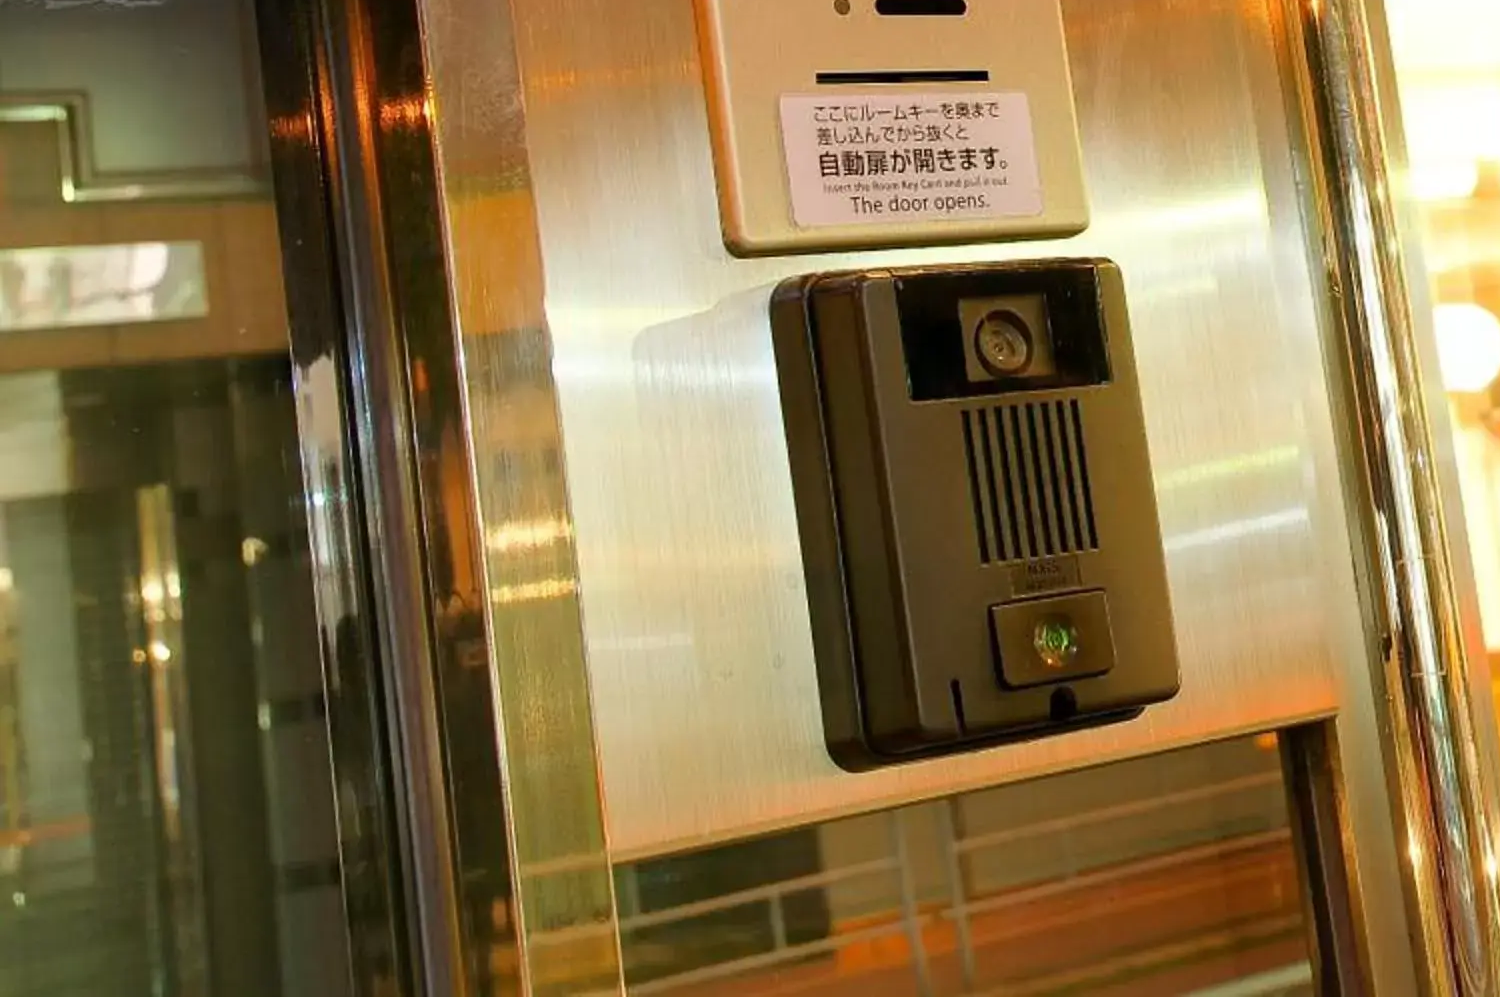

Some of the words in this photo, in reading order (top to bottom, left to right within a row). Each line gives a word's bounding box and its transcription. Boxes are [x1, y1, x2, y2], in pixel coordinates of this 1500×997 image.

[813, 101, 1001, 123] ここにルームキーを奥まで
[816, 124, 970, 146] 差し込んでから抜くと
[819, 146, 1008, 177] 自動扉が開きます。
[850, 196, 883, 214] The
[889, 194, 928, 213] door
[933, 193, 991, 213] opens.
